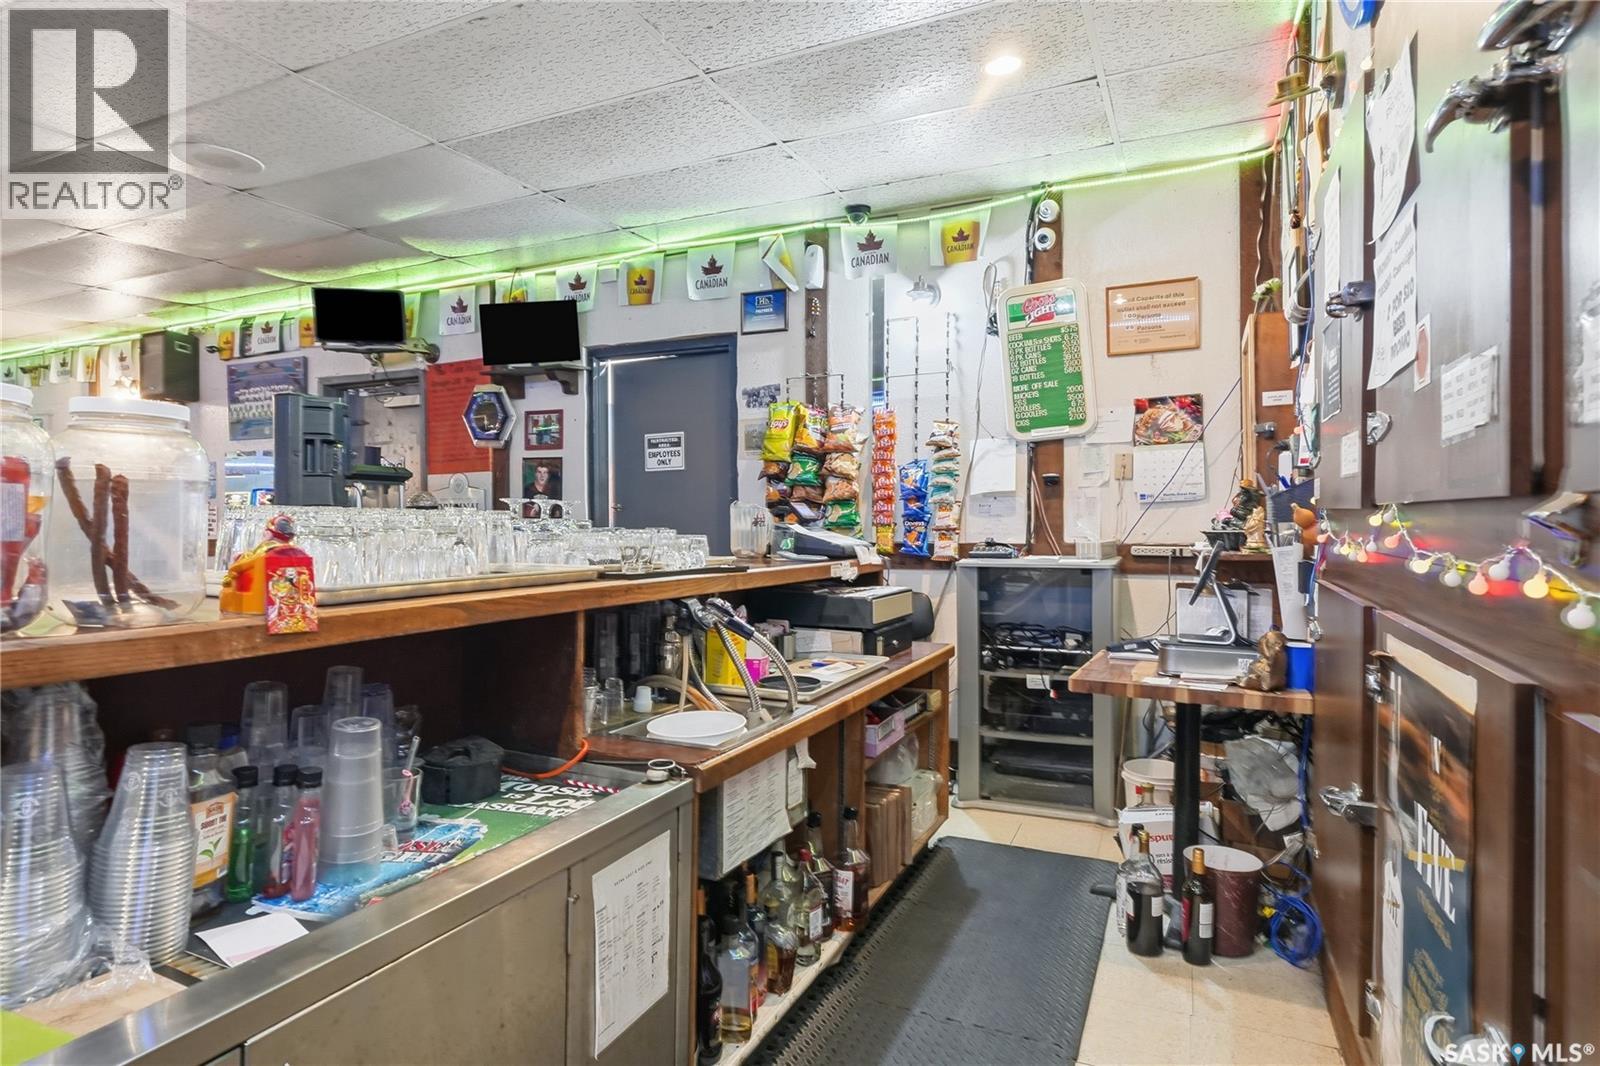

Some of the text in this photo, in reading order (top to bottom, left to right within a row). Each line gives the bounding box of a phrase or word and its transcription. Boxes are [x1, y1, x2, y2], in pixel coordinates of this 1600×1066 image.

[946, 241, 975, 253] CANADIAN
[850, 251, 890, 269] CANADIAN
[695, 276, 728, 290] CANADIAN
[648, 450, 681, 458] EMPLOYEES
